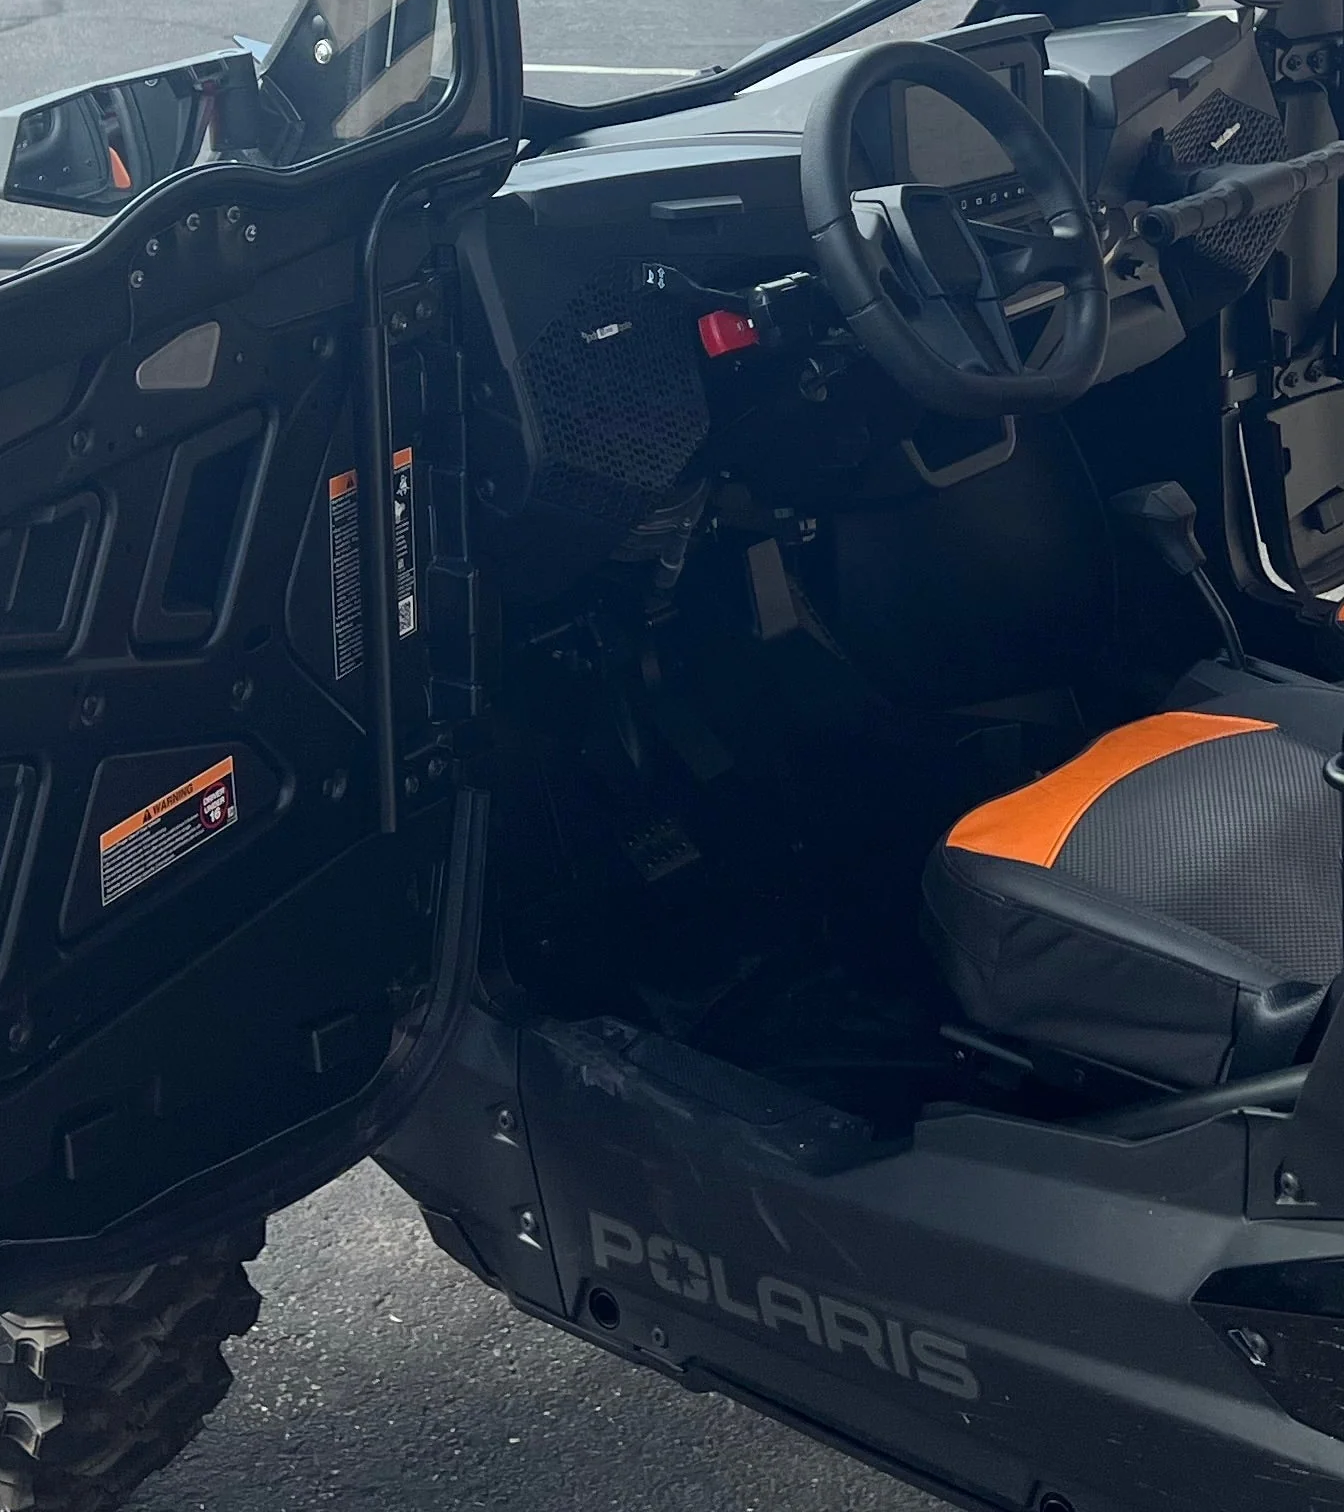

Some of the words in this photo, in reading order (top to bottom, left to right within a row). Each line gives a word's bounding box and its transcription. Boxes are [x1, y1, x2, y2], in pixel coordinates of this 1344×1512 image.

[152, 784, 194, 813] WARNING
[209, 807, 222, 822] 16
[588, 1208, 980, 1401] POLARIS
